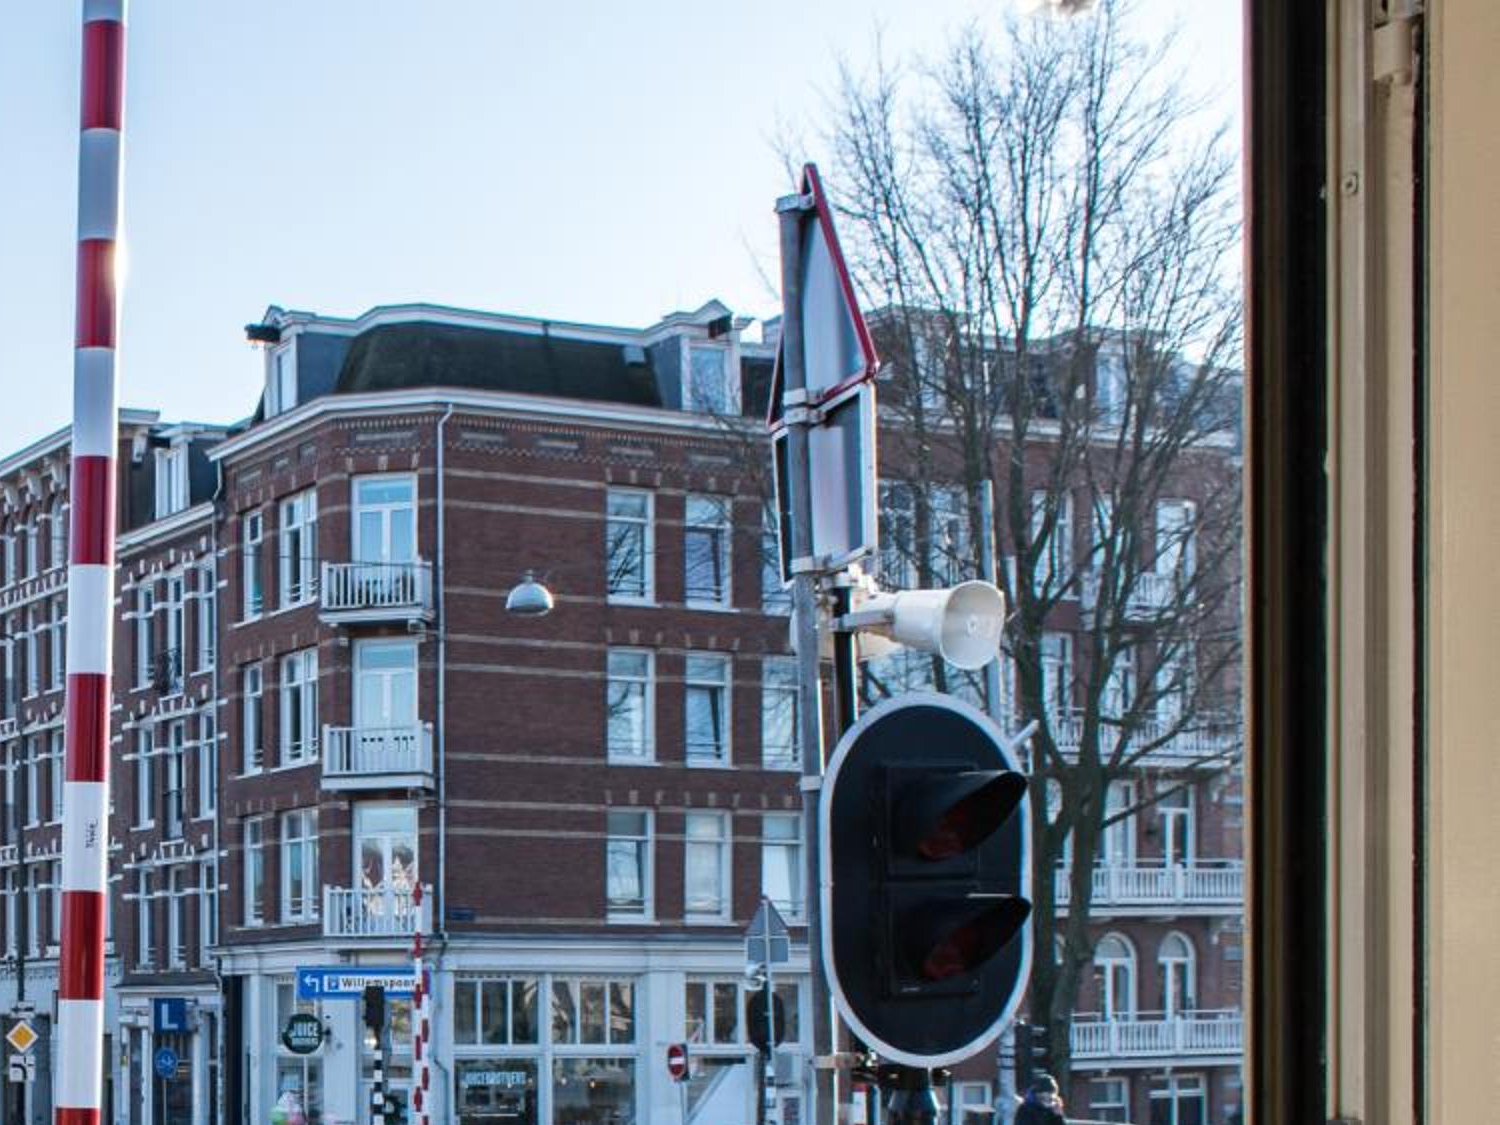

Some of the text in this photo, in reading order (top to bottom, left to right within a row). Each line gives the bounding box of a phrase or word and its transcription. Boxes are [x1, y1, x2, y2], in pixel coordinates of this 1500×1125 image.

[341, 977, 415, 989] Willemspoor
[161, 1003, 179, 1029] L
[291, 1022, 318, 1037] JUICE
